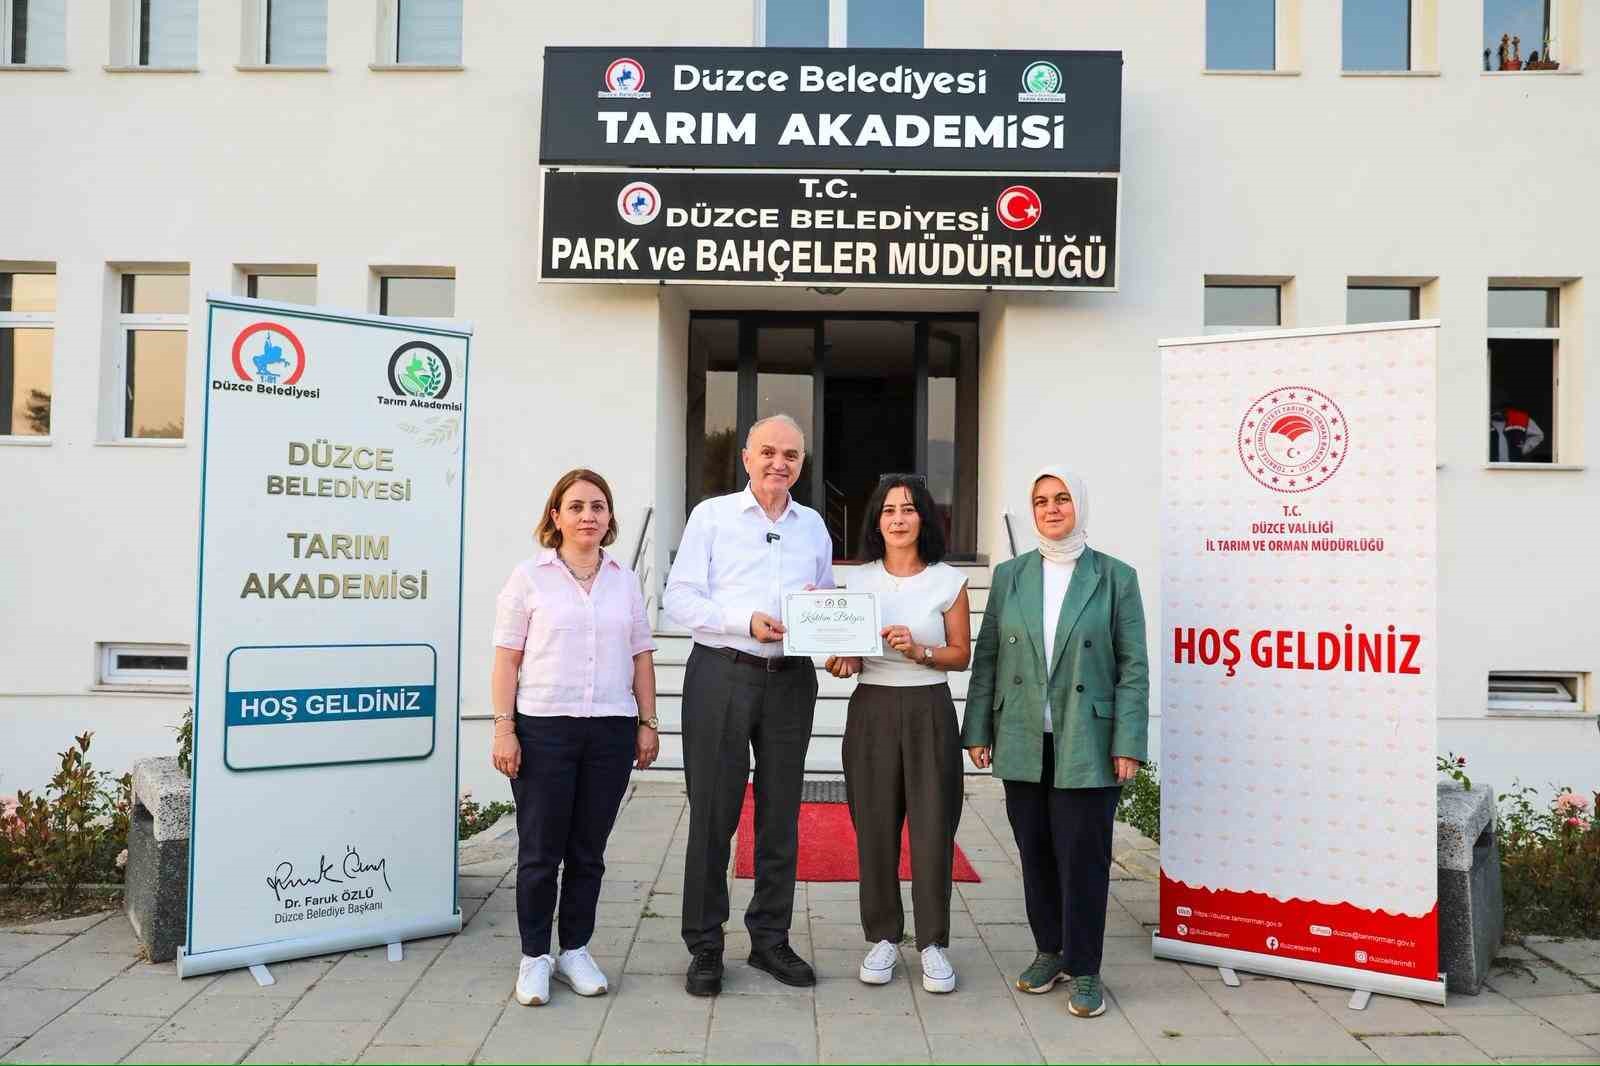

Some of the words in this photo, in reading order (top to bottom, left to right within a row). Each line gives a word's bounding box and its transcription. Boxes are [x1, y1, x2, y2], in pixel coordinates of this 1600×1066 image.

[673, 65, 789, 92] Düzce
[799, 65, 987, 100] Belediyesi
[597, 111, 757, 145] TARIM
[777, 112, 1065, 149] AKADEMİSİ
[799, 178, 857, 199] T.C.
[666, 203, 779, 228] DÜZCE
[790, 206, 990, 231] BELEDİYESİ
[551, 237, 640, 271] PARK
[648, 246, 686, 272] ve
[695, 239, 877, 281] BAHÇELER
[888, 234, 1107, 279] MÜDÜRLÜĞÜ
[212, 380, 253, 392] Düzce
[257, 384, 320, 399] Belediyesi
[377, 396, 407, 407] Tarım
[410, 400, 462, 412] Akademisi
[288, 439, 394, 472] DÜZCE
[266, 475, 412, 502] BELEDİYESİ
[1283, 505, 1302, 517] T.C.
[1252, 520, 1286, 535] DÜZCE
[1288, 519, 1334, 535] VALİLİĞİ
[286, 532, 389, 561] TARIM
[1206, 537, 1216, 552] İL
[1217, 539, 1251, 552] TARIM
[1253, 539, 1266, 552] VE
[1268, 539, 1309, 552] ORMAN
[1311, 537, 1384, 552] MÜDÜRLÜĞÜ
[239, 569, 428, 601] AKADEMİSİ
[1173, 627, 1242, 677] HOŞ
[1250, 623, 1422, 675] GELDİNİZ
[240, 697, 298, 721] HOŞ
[305, 689, 421, 717] GELDİNİZ
[284, 899, 301, 909] Dr.
[305, 894, 338, 906] Faruk
[341, 887, 374, 902] ÖZLÜ
[274, 912, 304, 924] Düzce
[306, 906, 345, 920] Belediye
[348, 901, 383, 914] Başkanı
